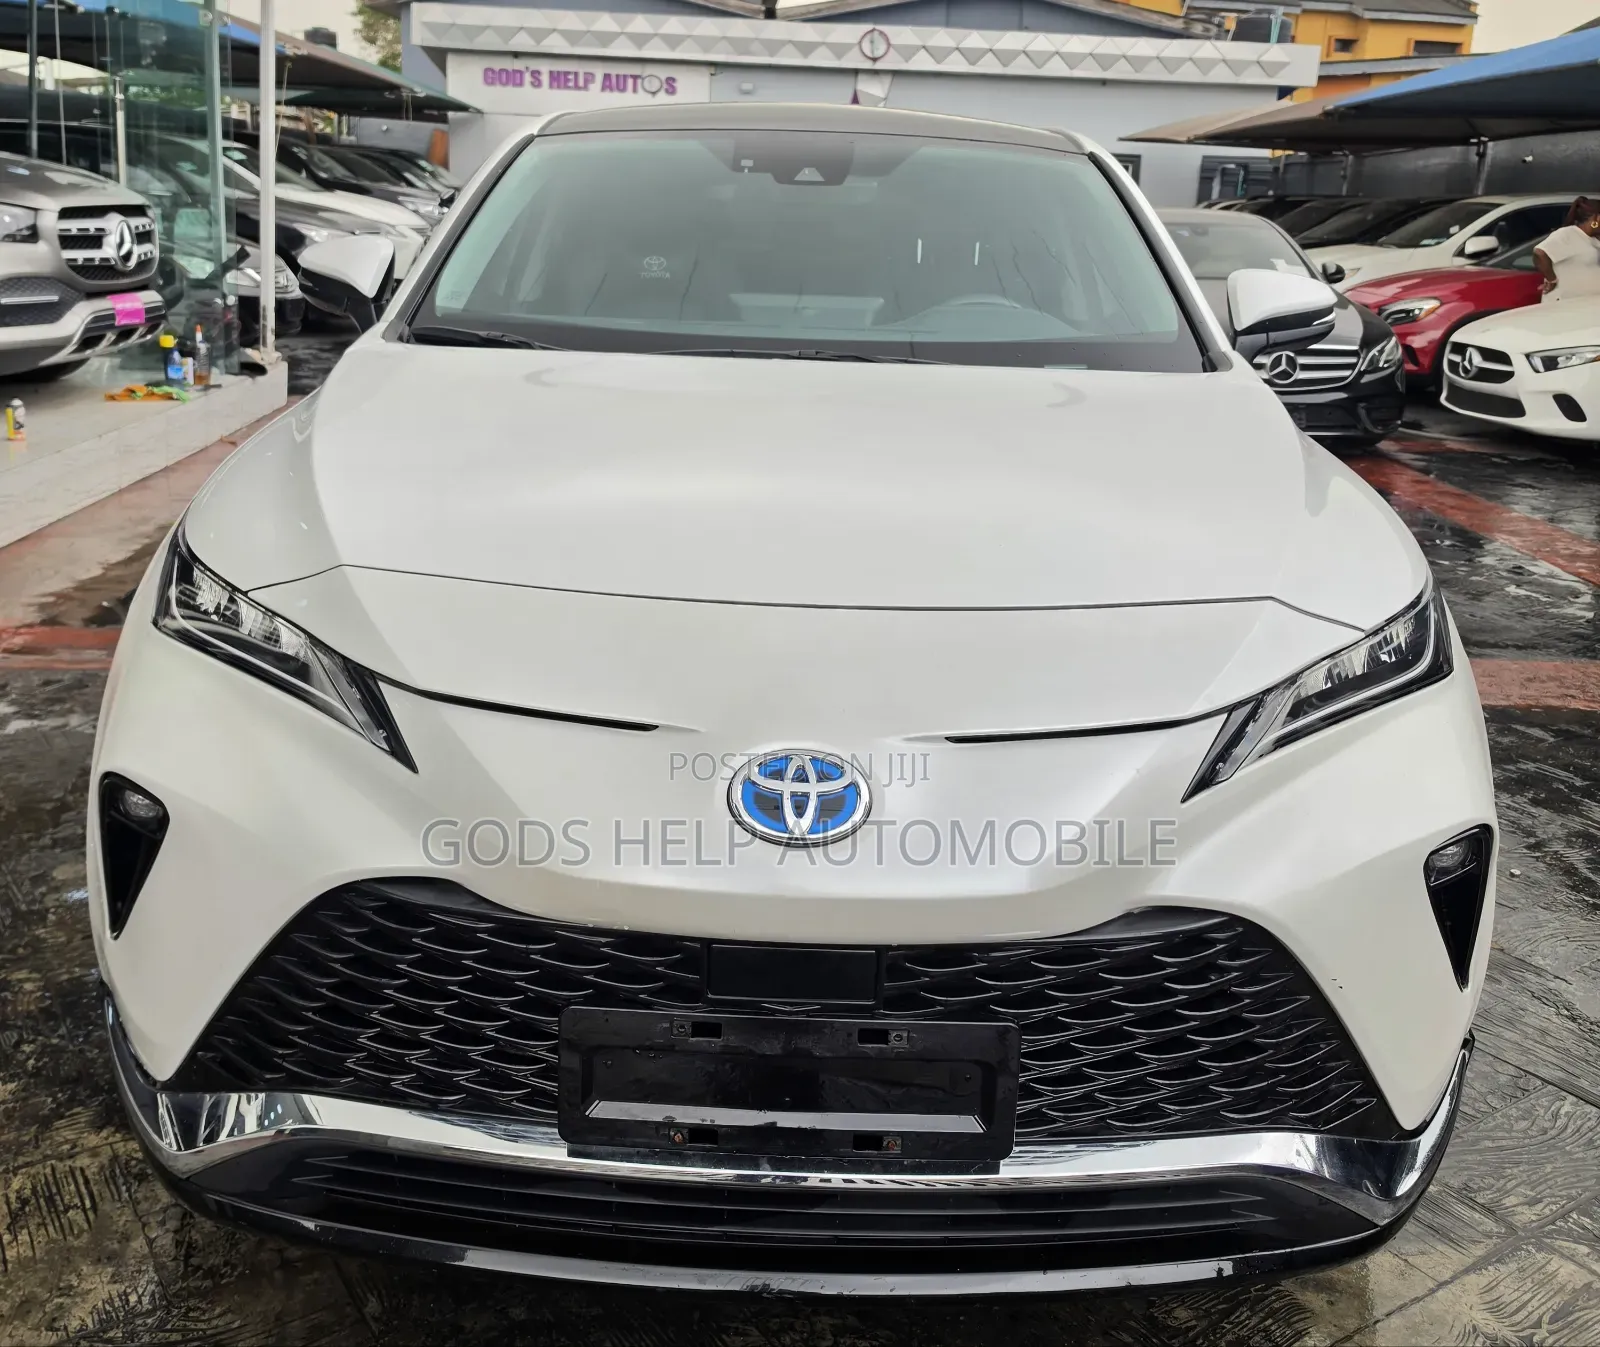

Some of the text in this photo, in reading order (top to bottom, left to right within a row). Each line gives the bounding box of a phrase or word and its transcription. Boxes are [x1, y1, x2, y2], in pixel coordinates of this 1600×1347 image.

[483, 66, 678, 97] GOD'S HELP AUTOS
